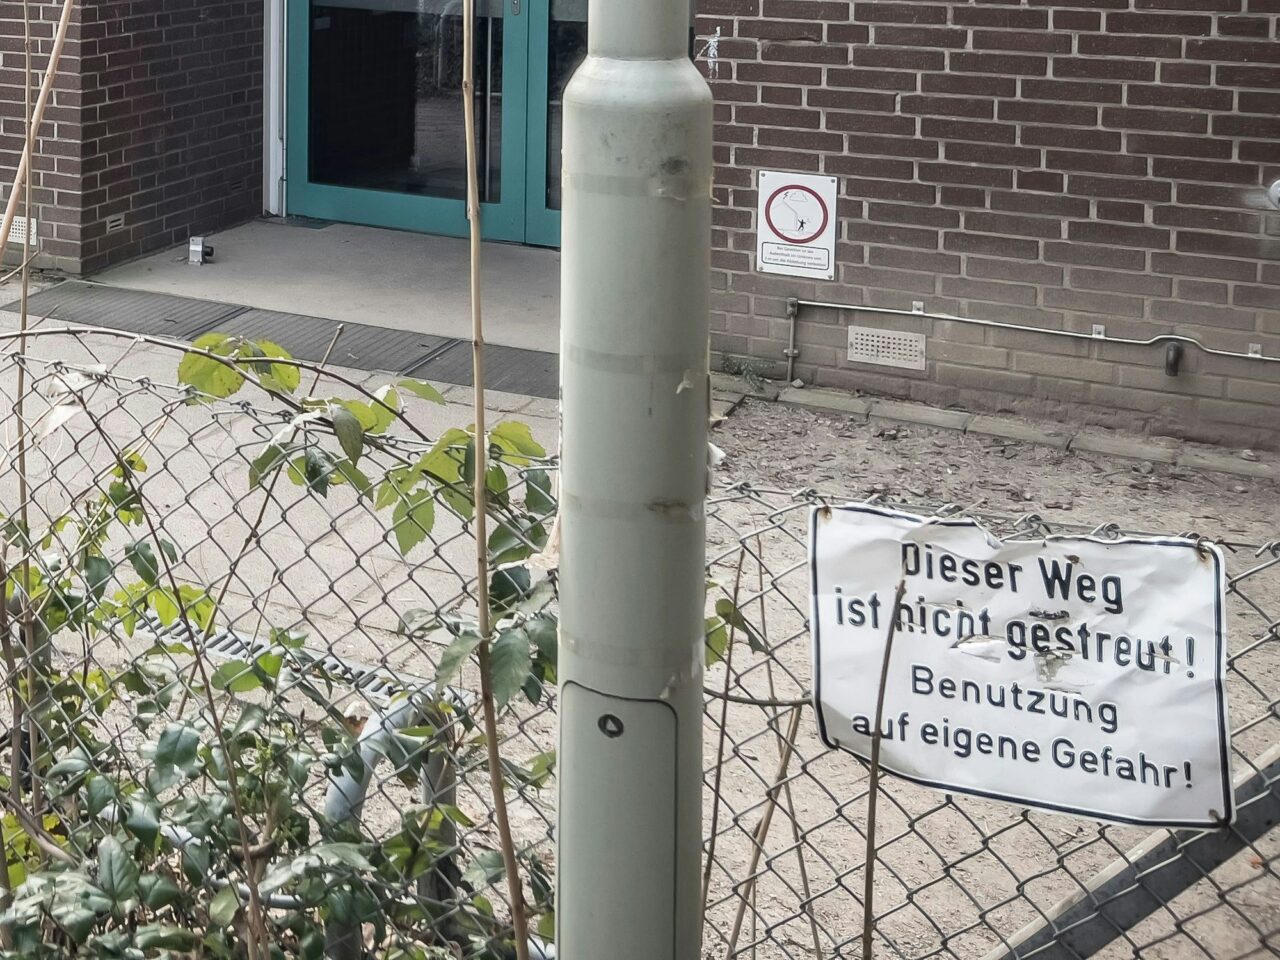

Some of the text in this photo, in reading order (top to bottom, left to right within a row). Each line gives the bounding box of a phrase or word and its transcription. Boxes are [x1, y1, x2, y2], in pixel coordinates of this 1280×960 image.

[834, 587, 882, 629] ist
[896, 595, 991, 641] nicht
[901, 542, 1124, 615] Dieser Weg
[911, 664, 1120, 734] Benutzung
[852, 711, 1194, 790] auf eigene Gefahr!
